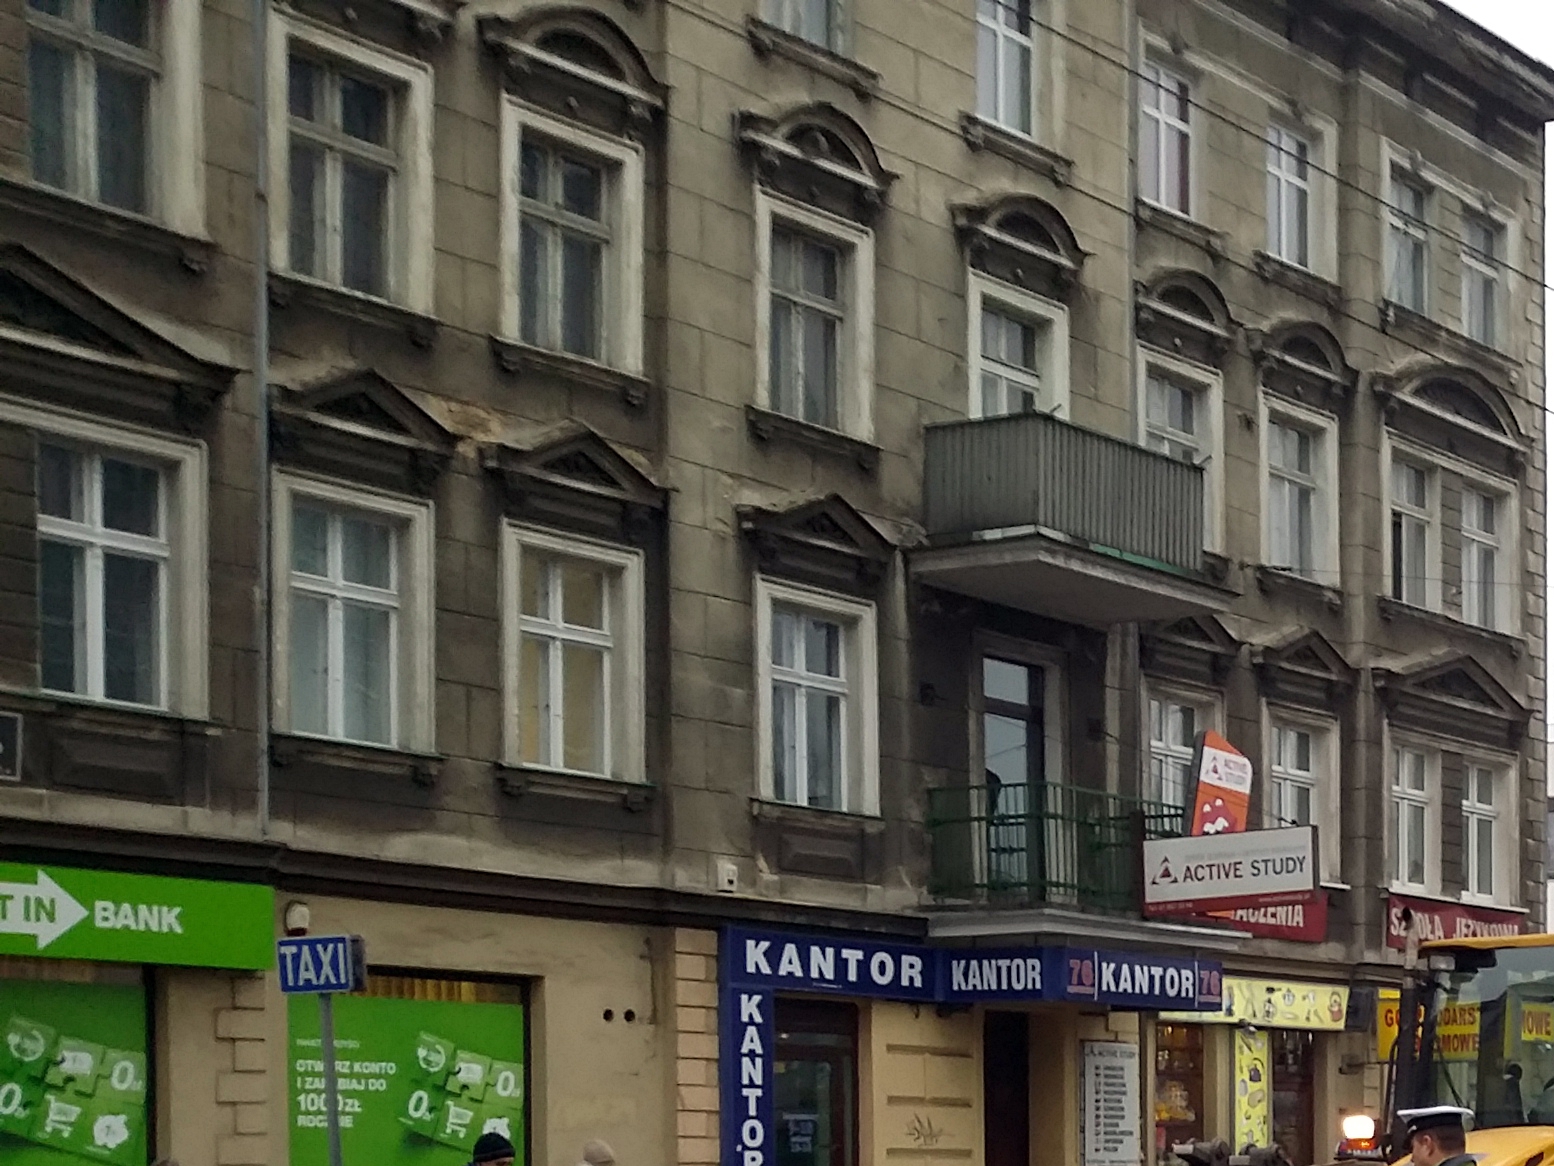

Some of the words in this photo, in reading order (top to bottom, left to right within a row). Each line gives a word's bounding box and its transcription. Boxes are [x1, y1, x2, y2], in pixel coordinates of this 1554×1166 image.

[1183, 861, 1243, 883] ACTIVE
[1250, 856, 1307, 877] STUDY
[23, 896, 57, 923] IN
[94, 900, 184, 934] BANK
[279, 942, 347, 987] TAXI
[745, 939, 923, 988] KANTOR
[952, 958, 1042, 991] KANTOR
[1101, 961, 1195, 998] KANTOR
[353, 1062, 396, 1075] KONTO
[368, 1079, 387, 1092] DO
